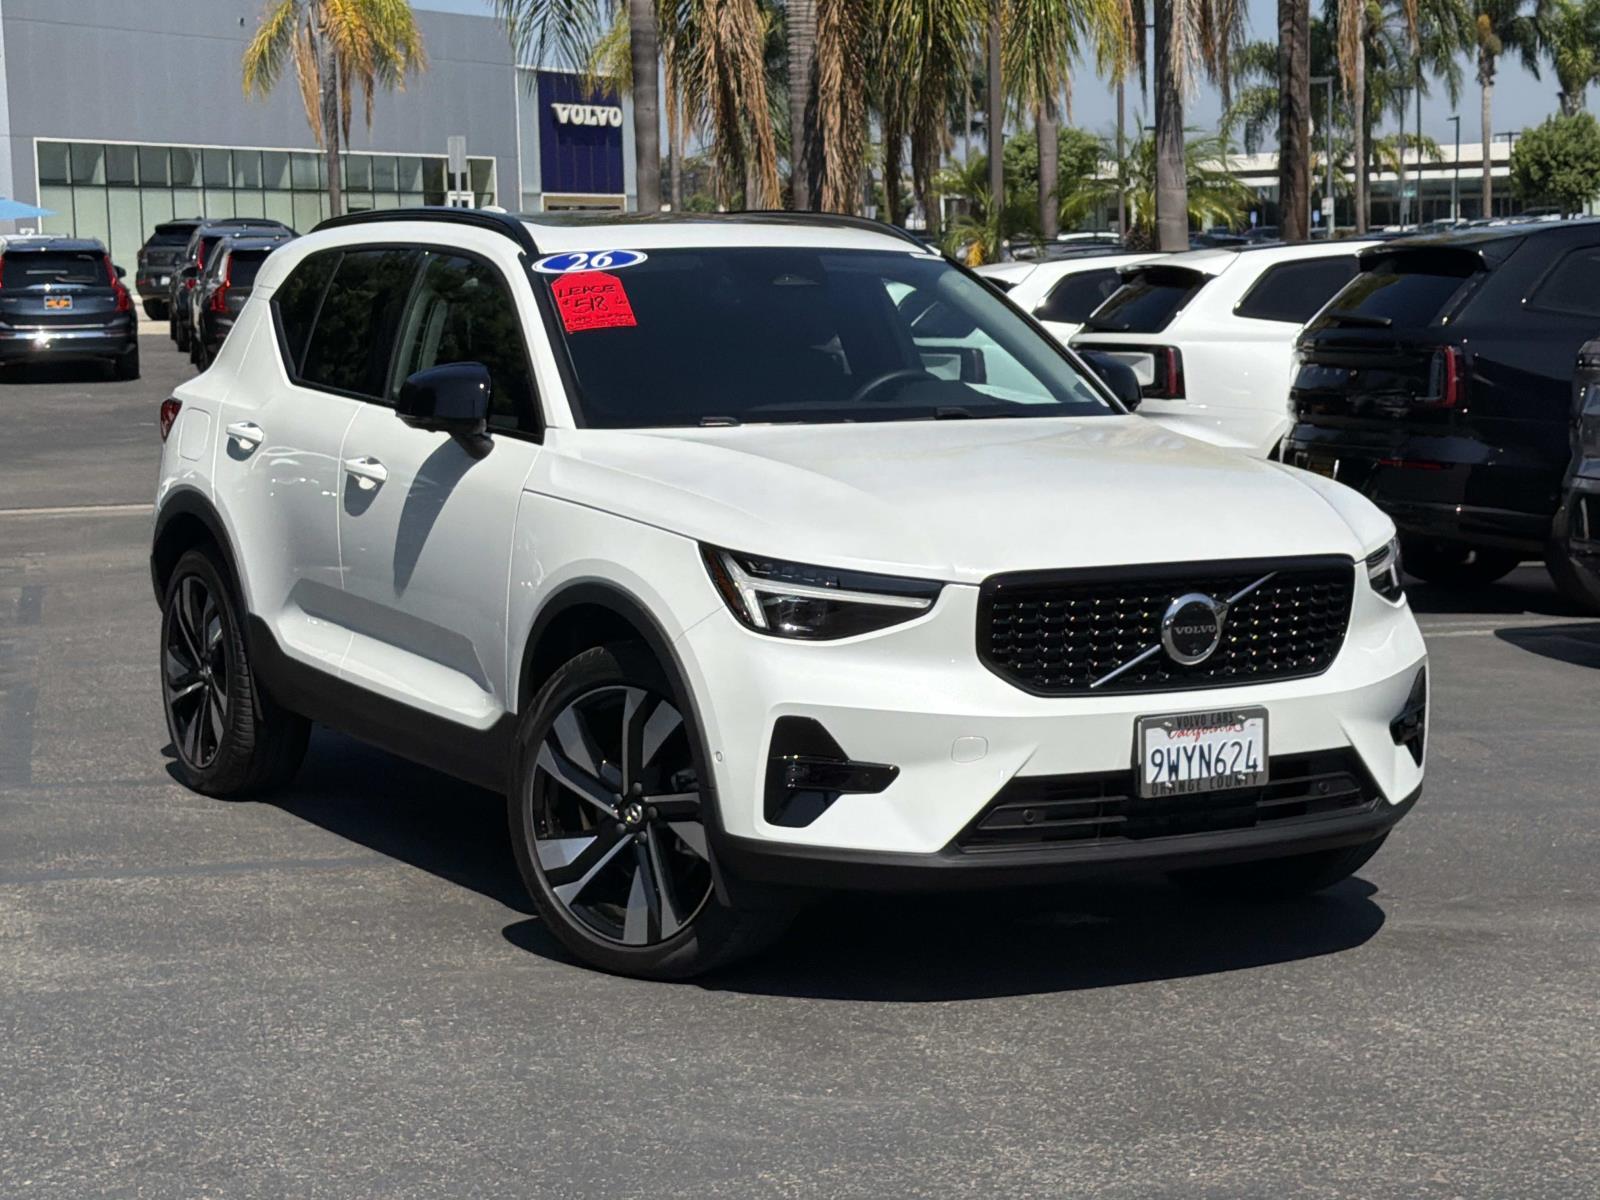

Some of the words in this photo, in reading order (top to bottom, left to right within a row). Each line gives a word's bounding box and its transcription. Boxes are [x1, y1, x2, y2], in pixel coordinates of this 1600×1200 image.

[551, 103, 622, 127] VOLVO
[565, 251, 614, 271] 26
[1174, 625, 1217, 634] VOLVO
[1176, 714, 1207, 729] VOLVO
[1210, 711, 1234, 726] CARS
[1150, 739, 1259, 784] 9WYN624
[1151, 778, 1202, 796] ORANGE
[1208, 772, 1258, 790] COUNTY
